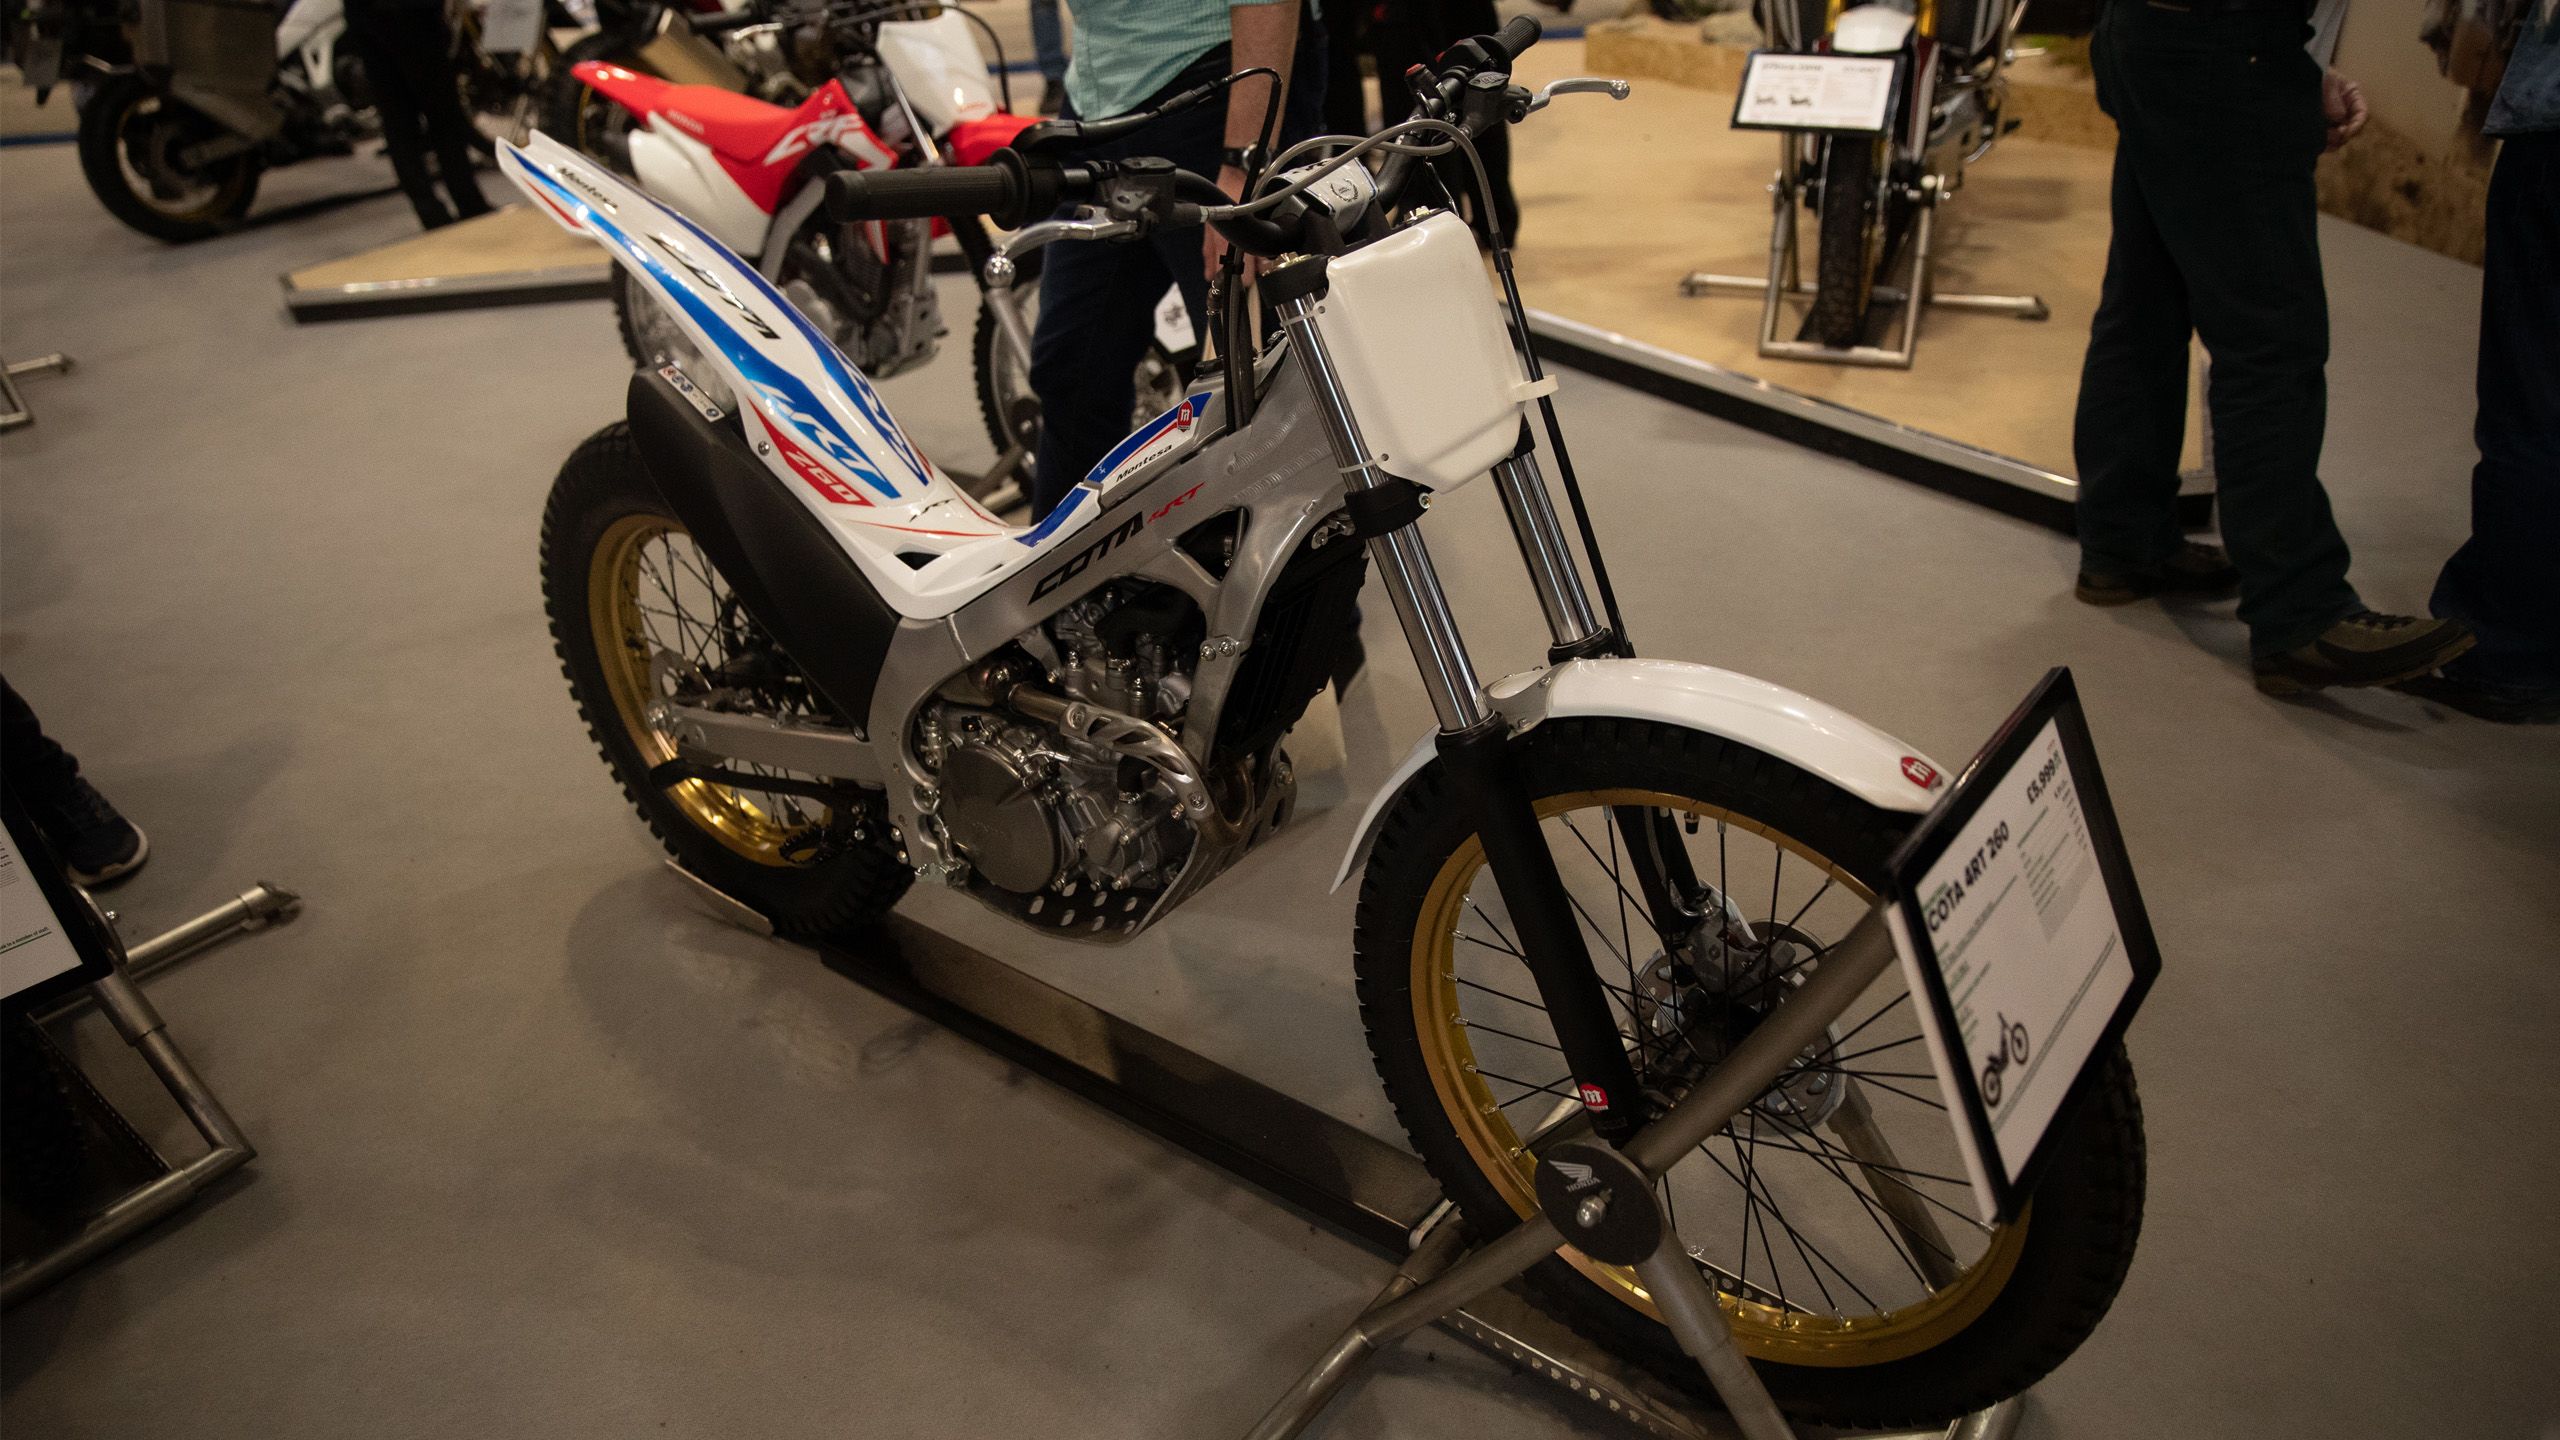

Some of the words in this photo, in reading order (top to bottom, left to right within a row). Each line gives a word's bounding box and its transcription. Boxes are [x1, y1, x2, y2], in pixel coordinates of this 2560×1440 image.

[558, 167, 618, 209] Montesa
[785, 450, 862, 502] 260
[1116, 444, 1172, 482] Montesa
[1027, 511, 1144, 606] COTA
[1928, 879, 1965, 933] COTA
[1965, 846, 1987, 887] 4RT
[1985, 820, 2009, 859] 260
[1566, 1177, 1601, 1192] HONDA
